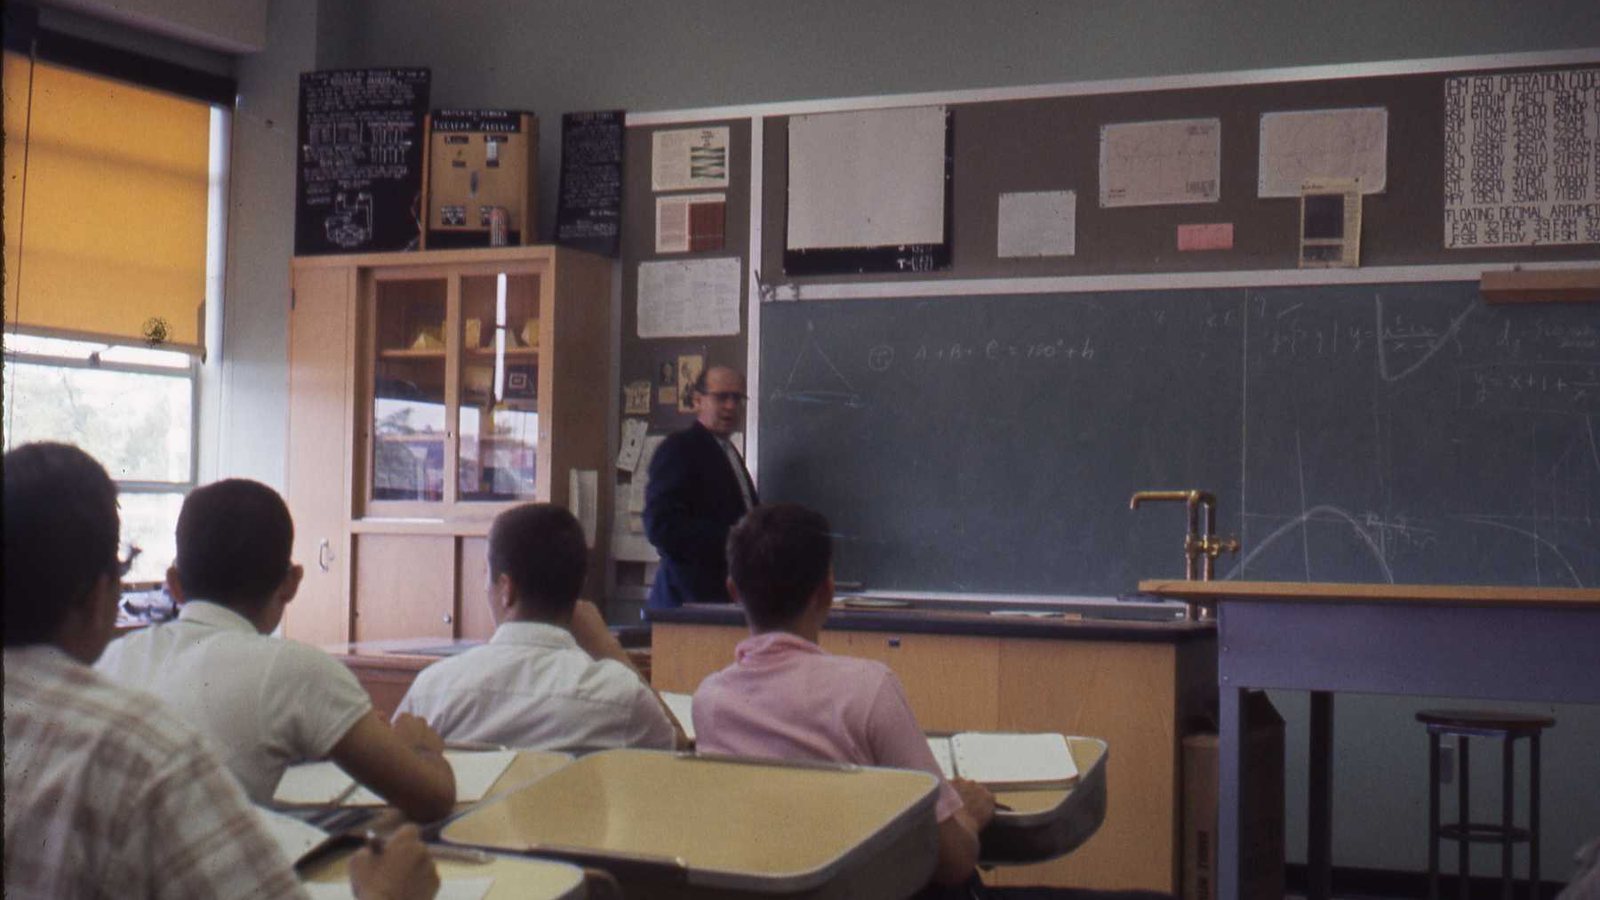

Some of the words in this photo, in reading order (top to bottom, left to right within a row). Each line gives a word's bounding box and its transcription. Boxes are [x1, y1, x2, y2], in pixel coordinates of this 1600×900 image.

[1501, 74, 1564, 93] OPERATION
[1445, 207, 1494, 223] FLOATING
[1500, 206, 1543, 221] DECIMAL
[1553, 218, 1577, 230] FAM
